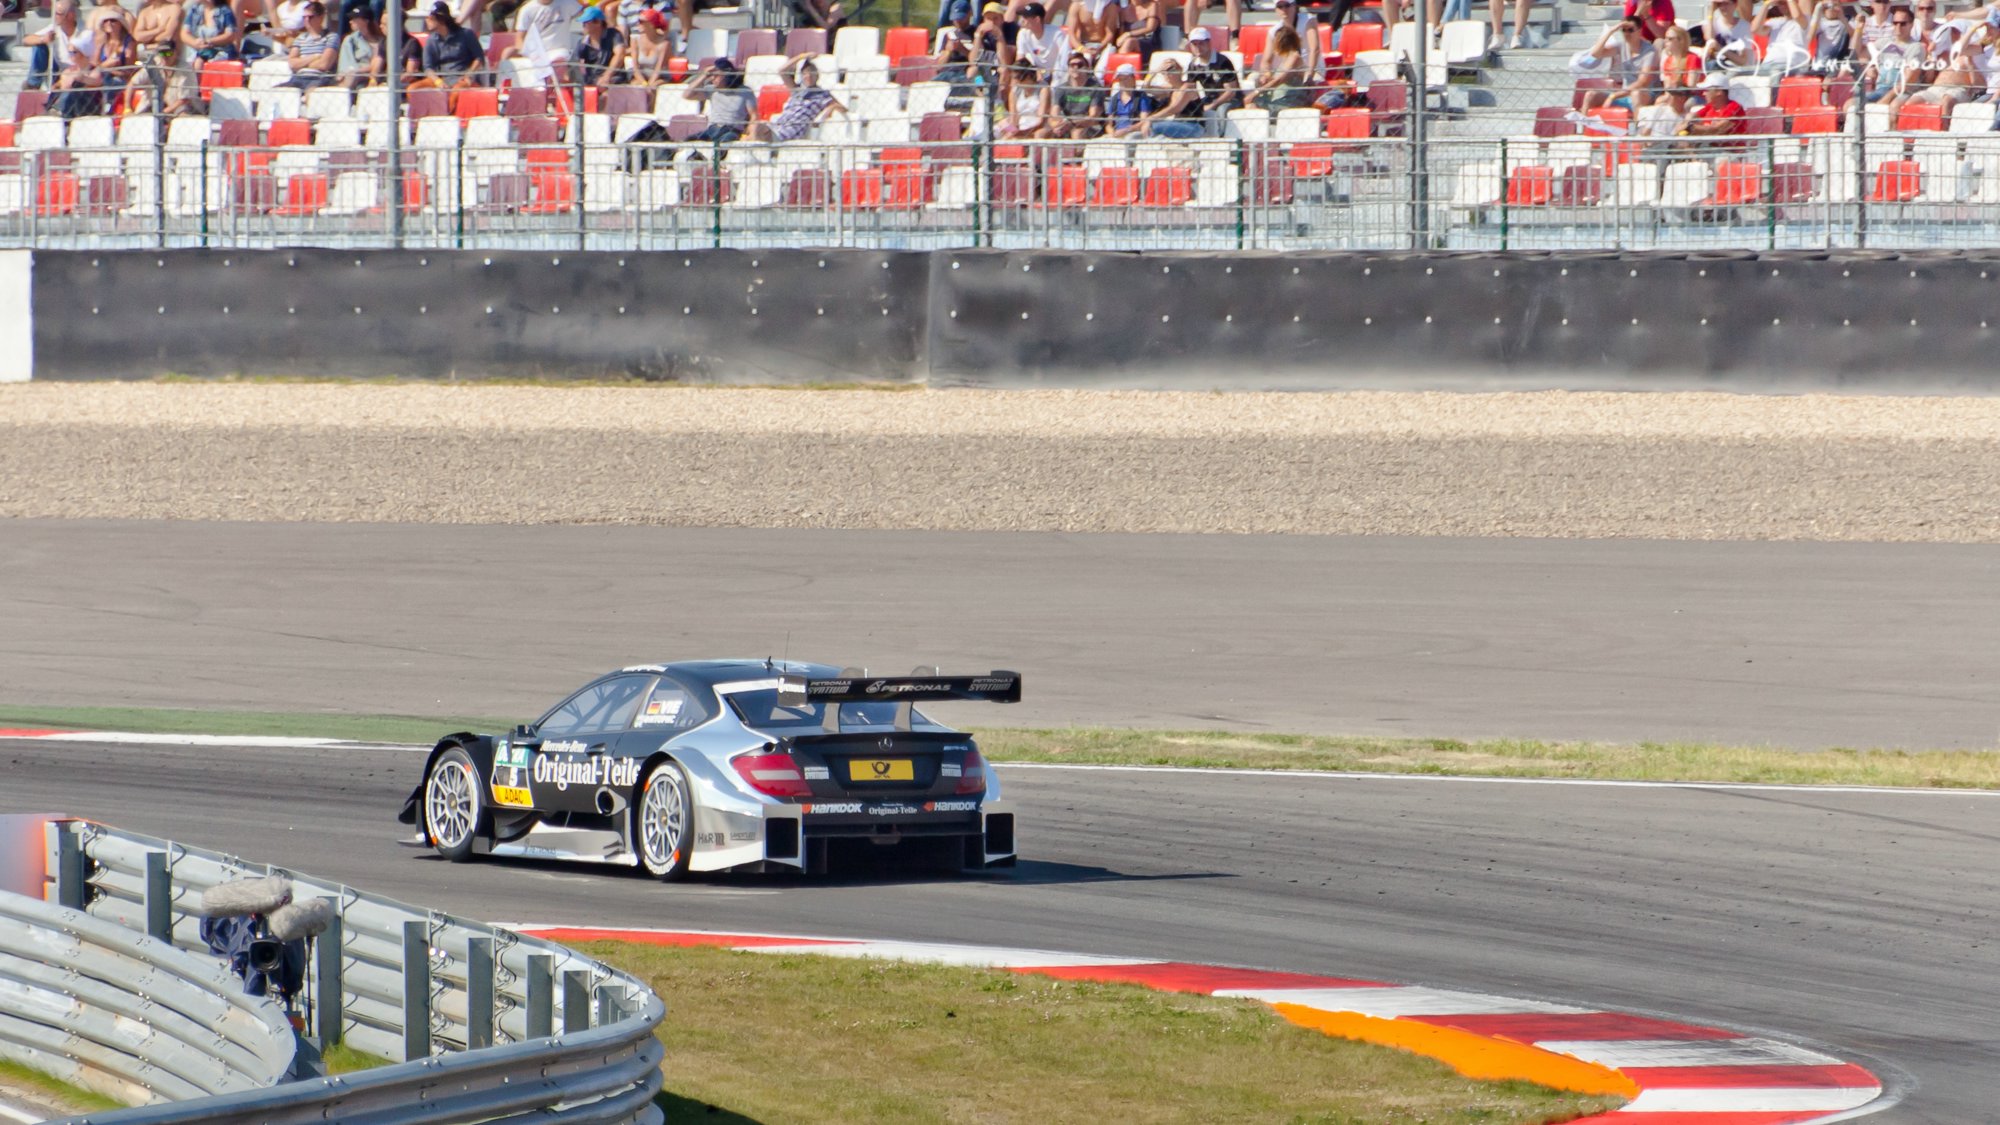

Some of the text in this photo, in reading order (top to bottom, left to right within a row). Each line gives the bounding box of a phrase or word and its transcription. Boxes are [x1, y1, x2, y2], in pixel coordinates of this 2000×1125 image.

[881, 684, 952, 692] PETRONAS
[534, 753, 642, 791] Original-Teile
[504, 789, 524, 805] ADAC
